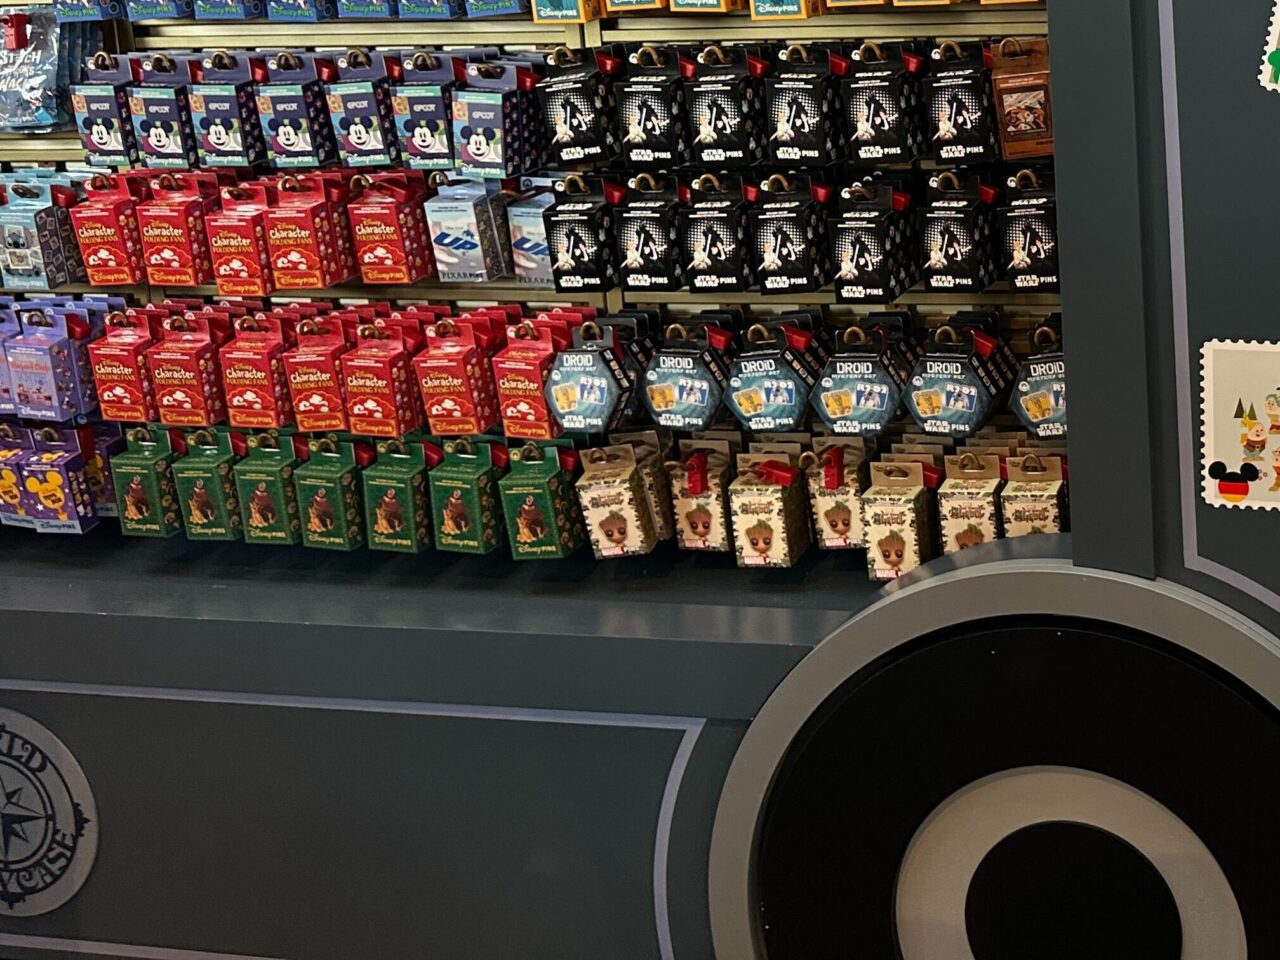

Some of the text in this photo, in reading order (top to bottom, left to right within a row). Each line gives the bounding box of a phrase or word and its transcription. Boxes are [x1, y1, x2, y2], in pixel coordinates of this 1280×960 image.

[859, 147, 901, 159] WARS PINS
[79, 227, 115, 237] Character
[144, 227, 183, 237] Character
[270, 228, 310, 238] Character
[356, 225, 395, 235] Character
[212, 237, 250, 247] Character
[434, 232, 478, 250] UP
[96, 365, 133, 375] Character
[155, 369, 194, 379] Character
[226, 371, 266, 379] Character
[291, 372, 330, 382] Character
[348, 378, 387, 388] Character
[422, 378, 462, 388] Character
[500, 380, 538, 390] Character
[833, 425, 860, 433] WARS
